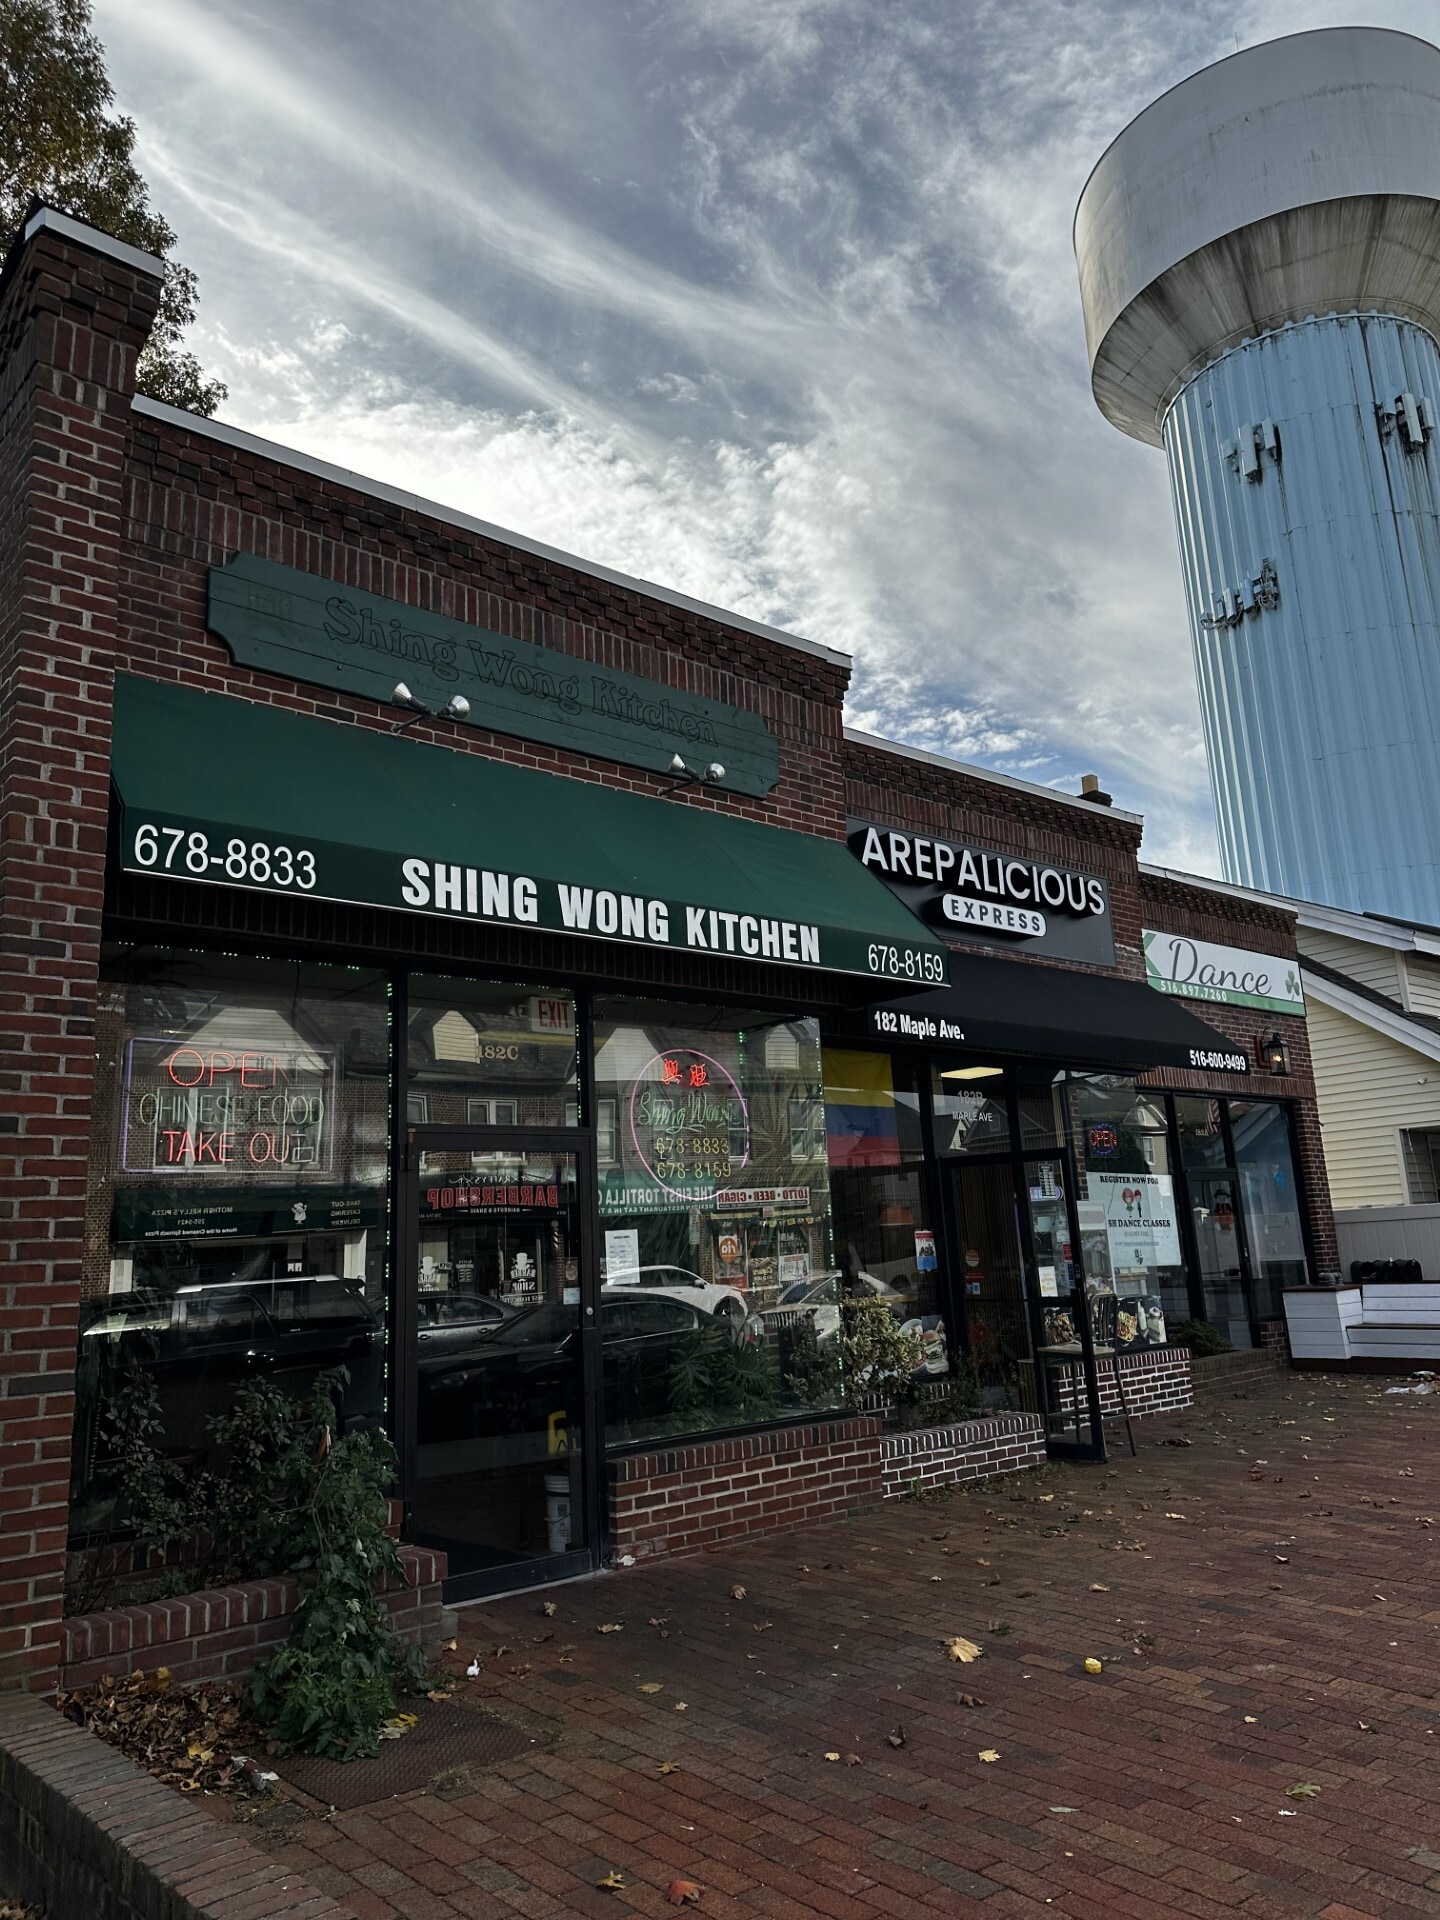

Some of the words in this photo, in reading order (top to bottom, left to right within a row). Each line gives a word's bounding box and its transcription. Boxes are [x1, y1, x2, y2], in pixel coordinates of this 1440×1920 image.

[322, 596, 460, 682] Shing
[466, 639, 582, 716] Wong
[591, 676, 719, 747] Kitchen
[134, 824, 317, 889] 678-8833
[861, 826, 1106, 916] AREPALICIOUS
[401, 858, 539, 923] SHING
[557, 883, 671, 943] WONG
[685, 905, 821, 963] KITCHEN
[950, 898, 1042, 933] EXPRESS
[868, 943, 944, 982] 678-8159
[1168, 938, 1273, 996] Dance
[1160, 981, 1228, 1003] 516.897.7260
[538, 999, 570, 1029] EXIT
[874, 1010, 898, 1032] 182
[899, 1014, 938, 1040] Maple
[939, 1019, 966, 1041] Ave.
[168, 1048, 298, 1089] OPEN
[478, 1045, 519, 1061] 182C
[1189, 1049, 1246, 1072] 516-600-9499
[140, 1093, 245, 1125] CHINESE
[257, 1094, 325, 1125] FOOD
[952, 1111, 978, 1121] MAPLE
[978, 1112, 993, 1122] AVE
[162, 1129, 236, 1163] TAKE
[248, 1131, 307, 1163] OUT
[655, 1137, 730, 1155] 678-8833
[1089, 1129, 1119, 1148] OPEN
[656, 1161, 732, 1180] 678-8159
[1099, 1175, 1131, 1184] REGISTER
[1131, 1176, 1147, 1185] NOW
[1118, 1219, 1142, 1228] DANCE
[1143, 1219, 1171, 1228] CLASSES
